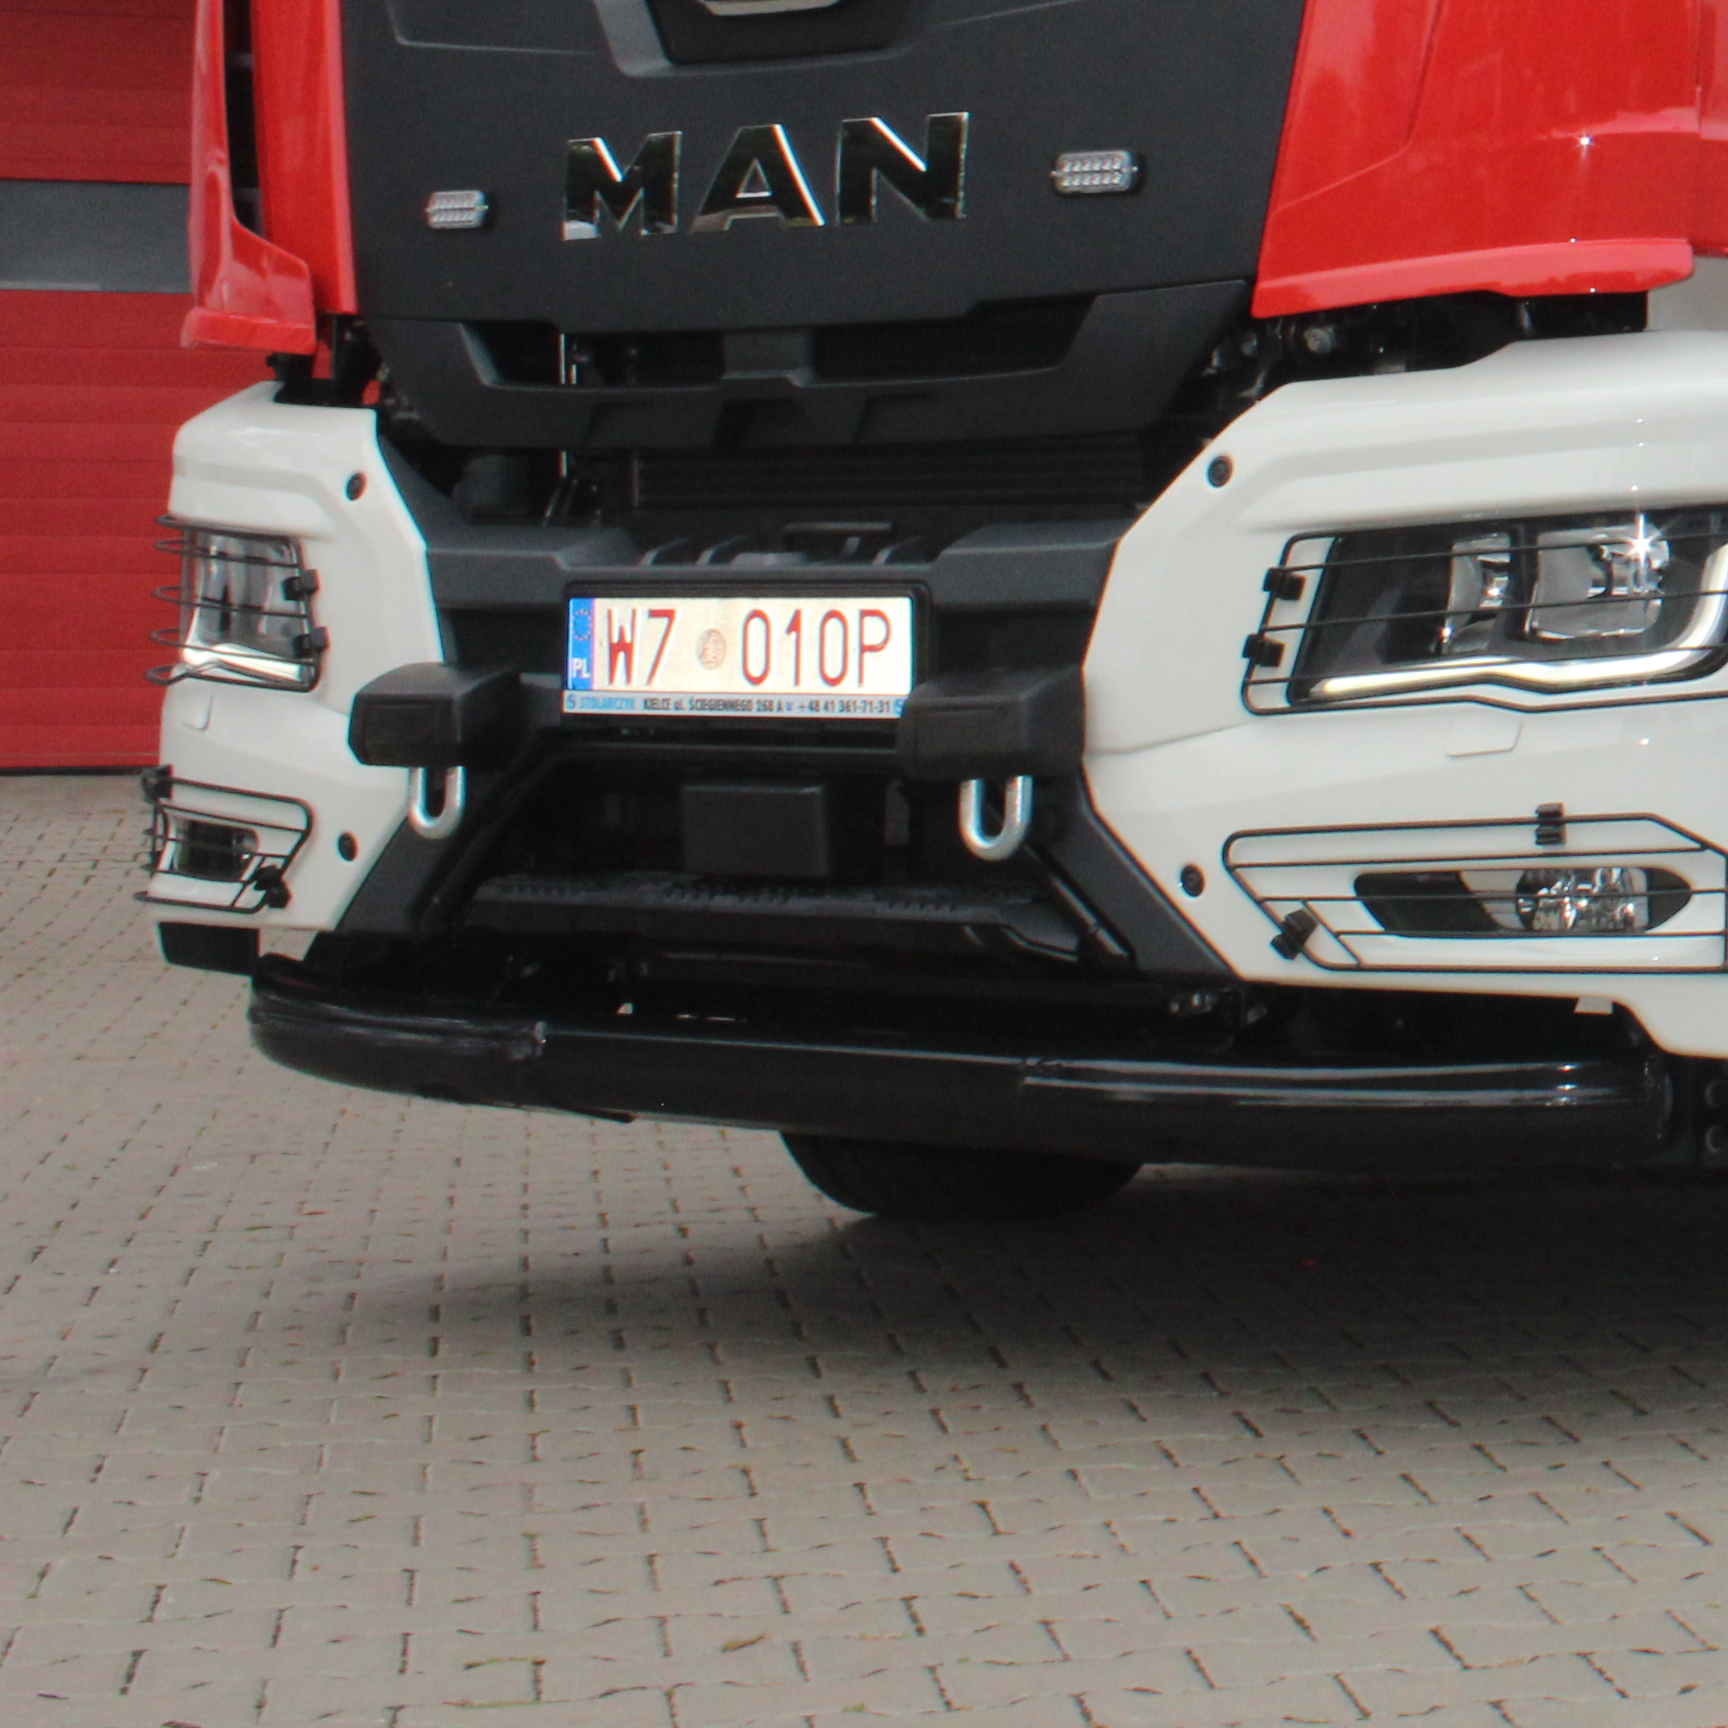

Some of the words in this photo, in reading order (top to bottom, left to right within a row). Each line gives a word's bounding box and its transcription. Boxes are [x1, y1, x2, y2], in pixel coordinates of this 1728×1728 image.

[562, 111, 969, 241] MAN
[573, 658, 591, 679] PL
[608, 608, 676, 685] W7
[742, 609, 892, 688] 010P
